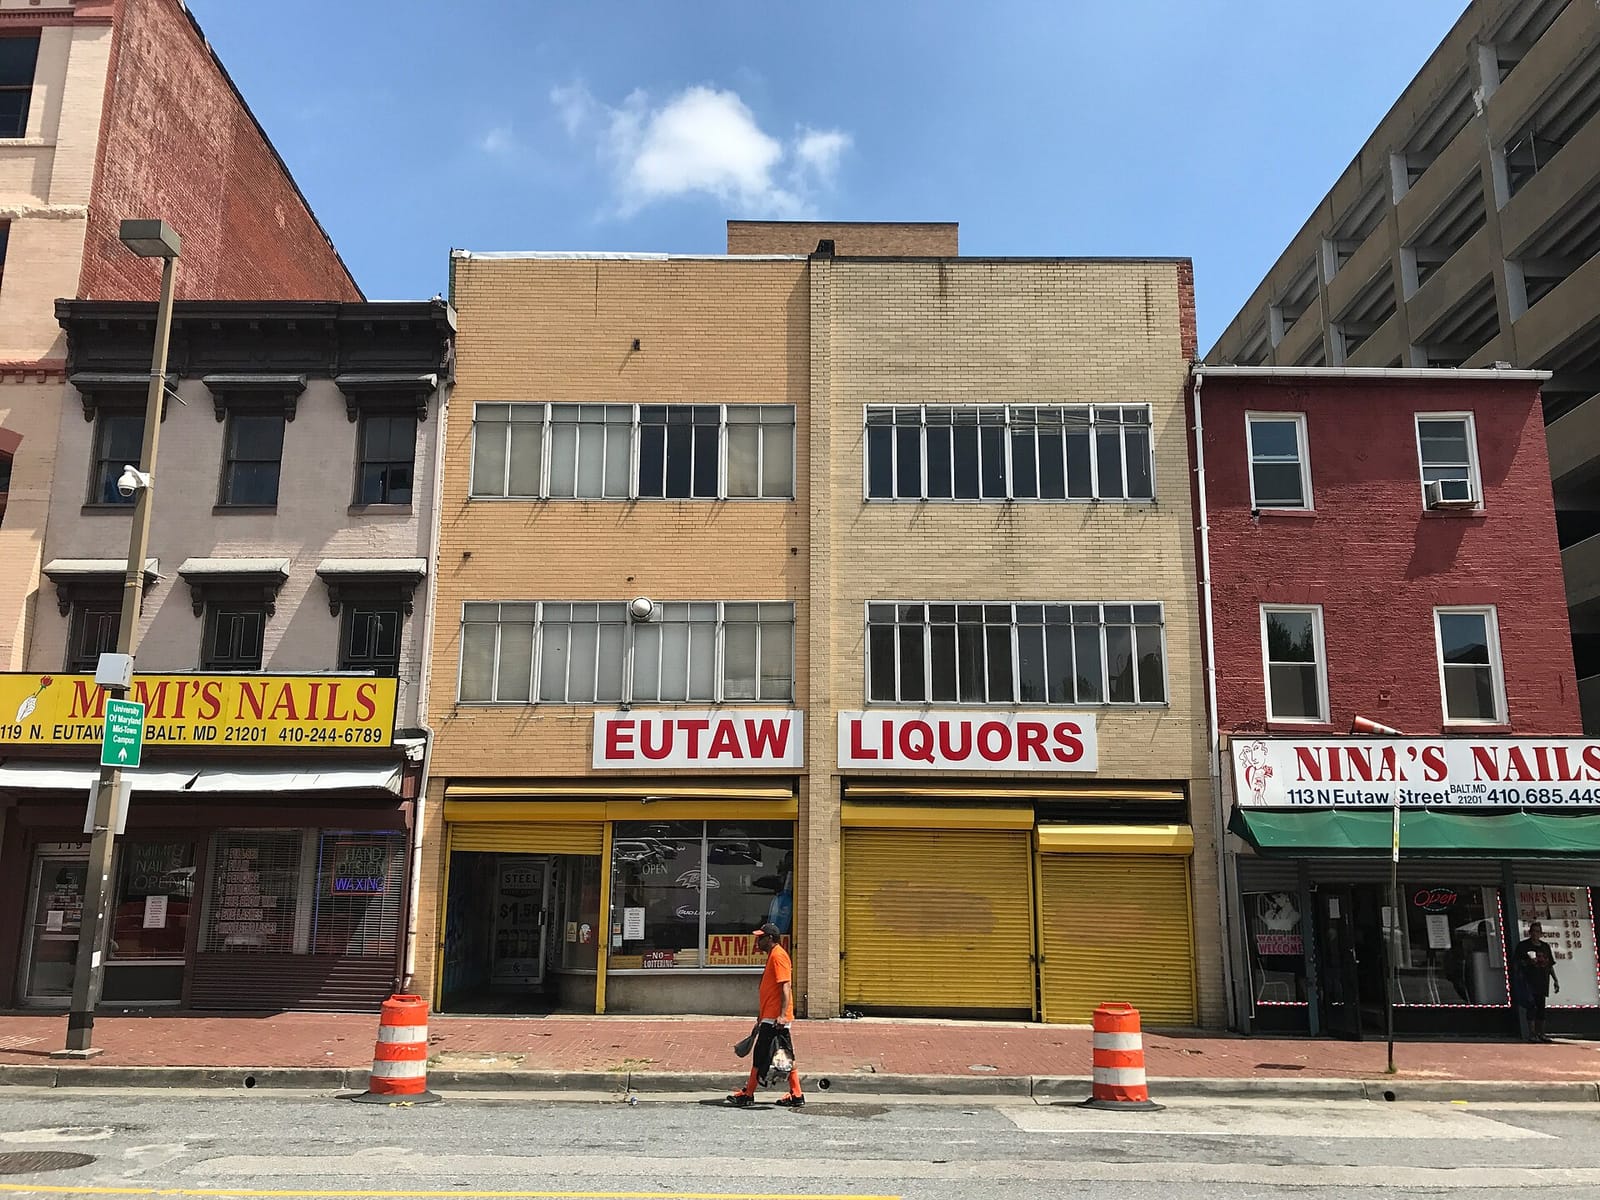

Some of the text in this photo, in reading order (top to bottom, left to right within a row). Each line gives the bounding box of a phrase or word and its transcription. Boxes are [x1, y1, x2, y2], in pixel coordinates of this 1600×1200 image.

[68, 680, 377, 721] MMI'S NAILS
[113, 704, 139, 716] University
[109, 714, 142, 725] Of Maryland
[1, 725, 22, 739] 119
[30, 725, 44, 739] N.
[146, 725, 187, 740] BALT.
[193, 726, 217, 740] MD
[225, 727, 267, 741] 21201
[279, 727, 382, 742] 410-244-6789
[112, 725, 137, 734] Mid-Town
[113, 735, 135, 745] Campus
[605, 719, 791, 760] EUTAW
[850, 720, 1084, 764] LIQUORS
[1293, 746, 1600, 782] NINA'S NAILS
[1287, 788, 1451, 804] 113 N Eutaw Street
[1458, 795, 1482, 804] 21201
[345, 848, 382, 861] HAND
[338, 862, 384, 875] DESIGN
[642, 863, 668, 875] OPEN
[335, 877, 385, 892] WAXING
[505, 874, 537, 884] STEEL
[1414, 890, 1457, 907] Open
[1520, 892, 1576, 904] NINA'S NAILS
[1571, 920, 1579, 928] 12
[710, 936, 748, 956] ATM
[1258, 943, 1303, 954] WELCOME
[652, 952, 664, 960] NO
[644, 959, 674, 968] LOITERING
